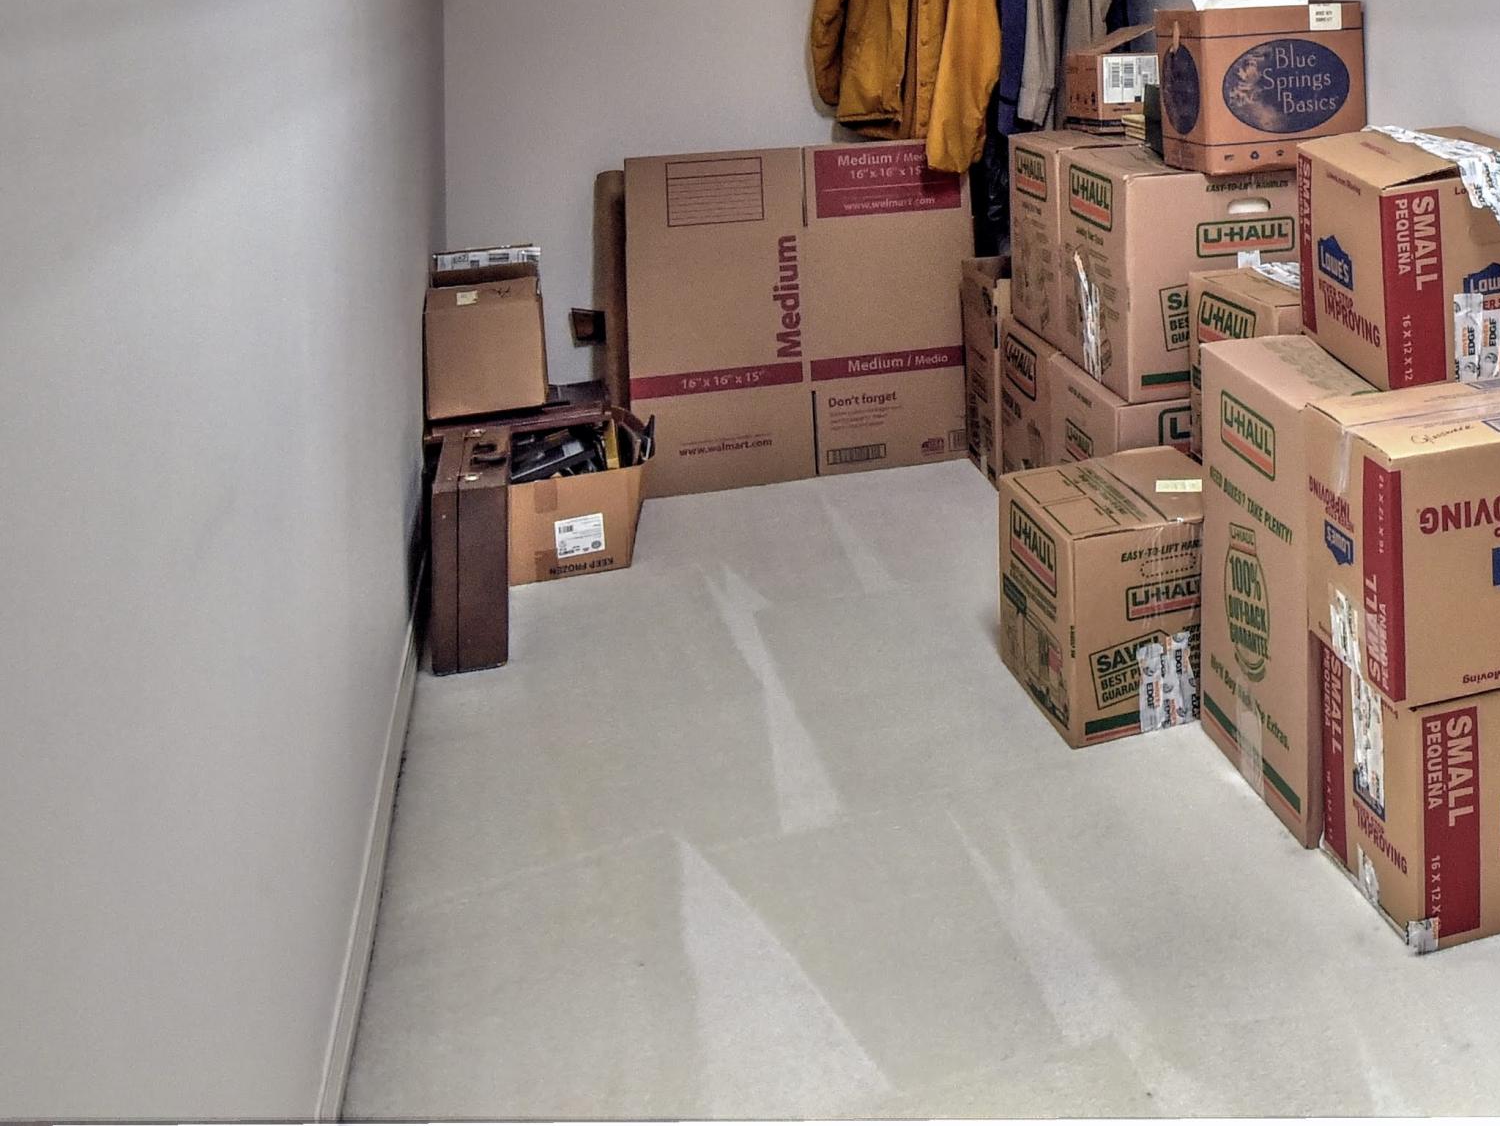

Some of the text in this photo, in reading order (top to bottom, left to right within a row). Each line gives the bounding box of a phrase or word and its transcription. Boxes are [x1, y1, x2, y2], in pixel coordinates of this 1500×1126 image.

[1275, 44, 1317, 68] Blue
[1262, 68, 1332, 101] Springs
[1282, 93, 1337, 114] Basics
[838, 153, 892, 167] Medium
[1017, 158, 1045, 183] U-HAUL
[1072, 173, 1110, 211] U-HAUL
[1203, 223, 1289, 244] U-HAUL
[1395, 199, 1412, 275] PEQUEÑA
[1412, 195, 1438, 291] SMALL
[1320, 246, 1350, 283] LOWE'S
[773, 235, 803, 358] Medium
[1169, 319, 1189, 332] BES
[1201, 300, 1249, 339] U-HAUL
[1322, 287, 1381, 348] IMPROVING
[1402, 315, 1411, 327] 16
[1489, 317, 1497, 347] EDGE
[848, 356, 903, 373] Medium
[914, 353, 949, 365] Medio
[1403, 343, 1412, 355] 12
[1404, 368, 1413, 381] 12
[828, 390, 898, 408] Don't forget
[1224, 400, 1272, 456] U-HAUL
[678, 437, 773, 457] www.walmart.com
[1309, 475, 1350, 524] IMPROVING
[1247, 498, 1263, 522] TAKE
[1264, 511, 1293, 545] PLENTY!
[1013, 510, 1053, 571] U-HAUL
[1121, 543, 1179, 563] EASY-TO-LIFT
[549, 557, 614, 575] KEEP FROZEN
[1229, 556, 1262, 601] 100%
[1132, 578, 1200, 606] U-HAU
[1366, 574, 1381, 682] SMALL
[1100, 670, 1130, 691] BEST
[1330, 654, 1342, 755] SMALL
[1426, 720, 1445, 810] PEQUEÑA
[1446, 715, 1474, 827] SMALL
[1357, 806, 1408, 875] IMPROVING
[1431, 855, 1441, 870] 16
[1432, 888, 1441, 902] 12
